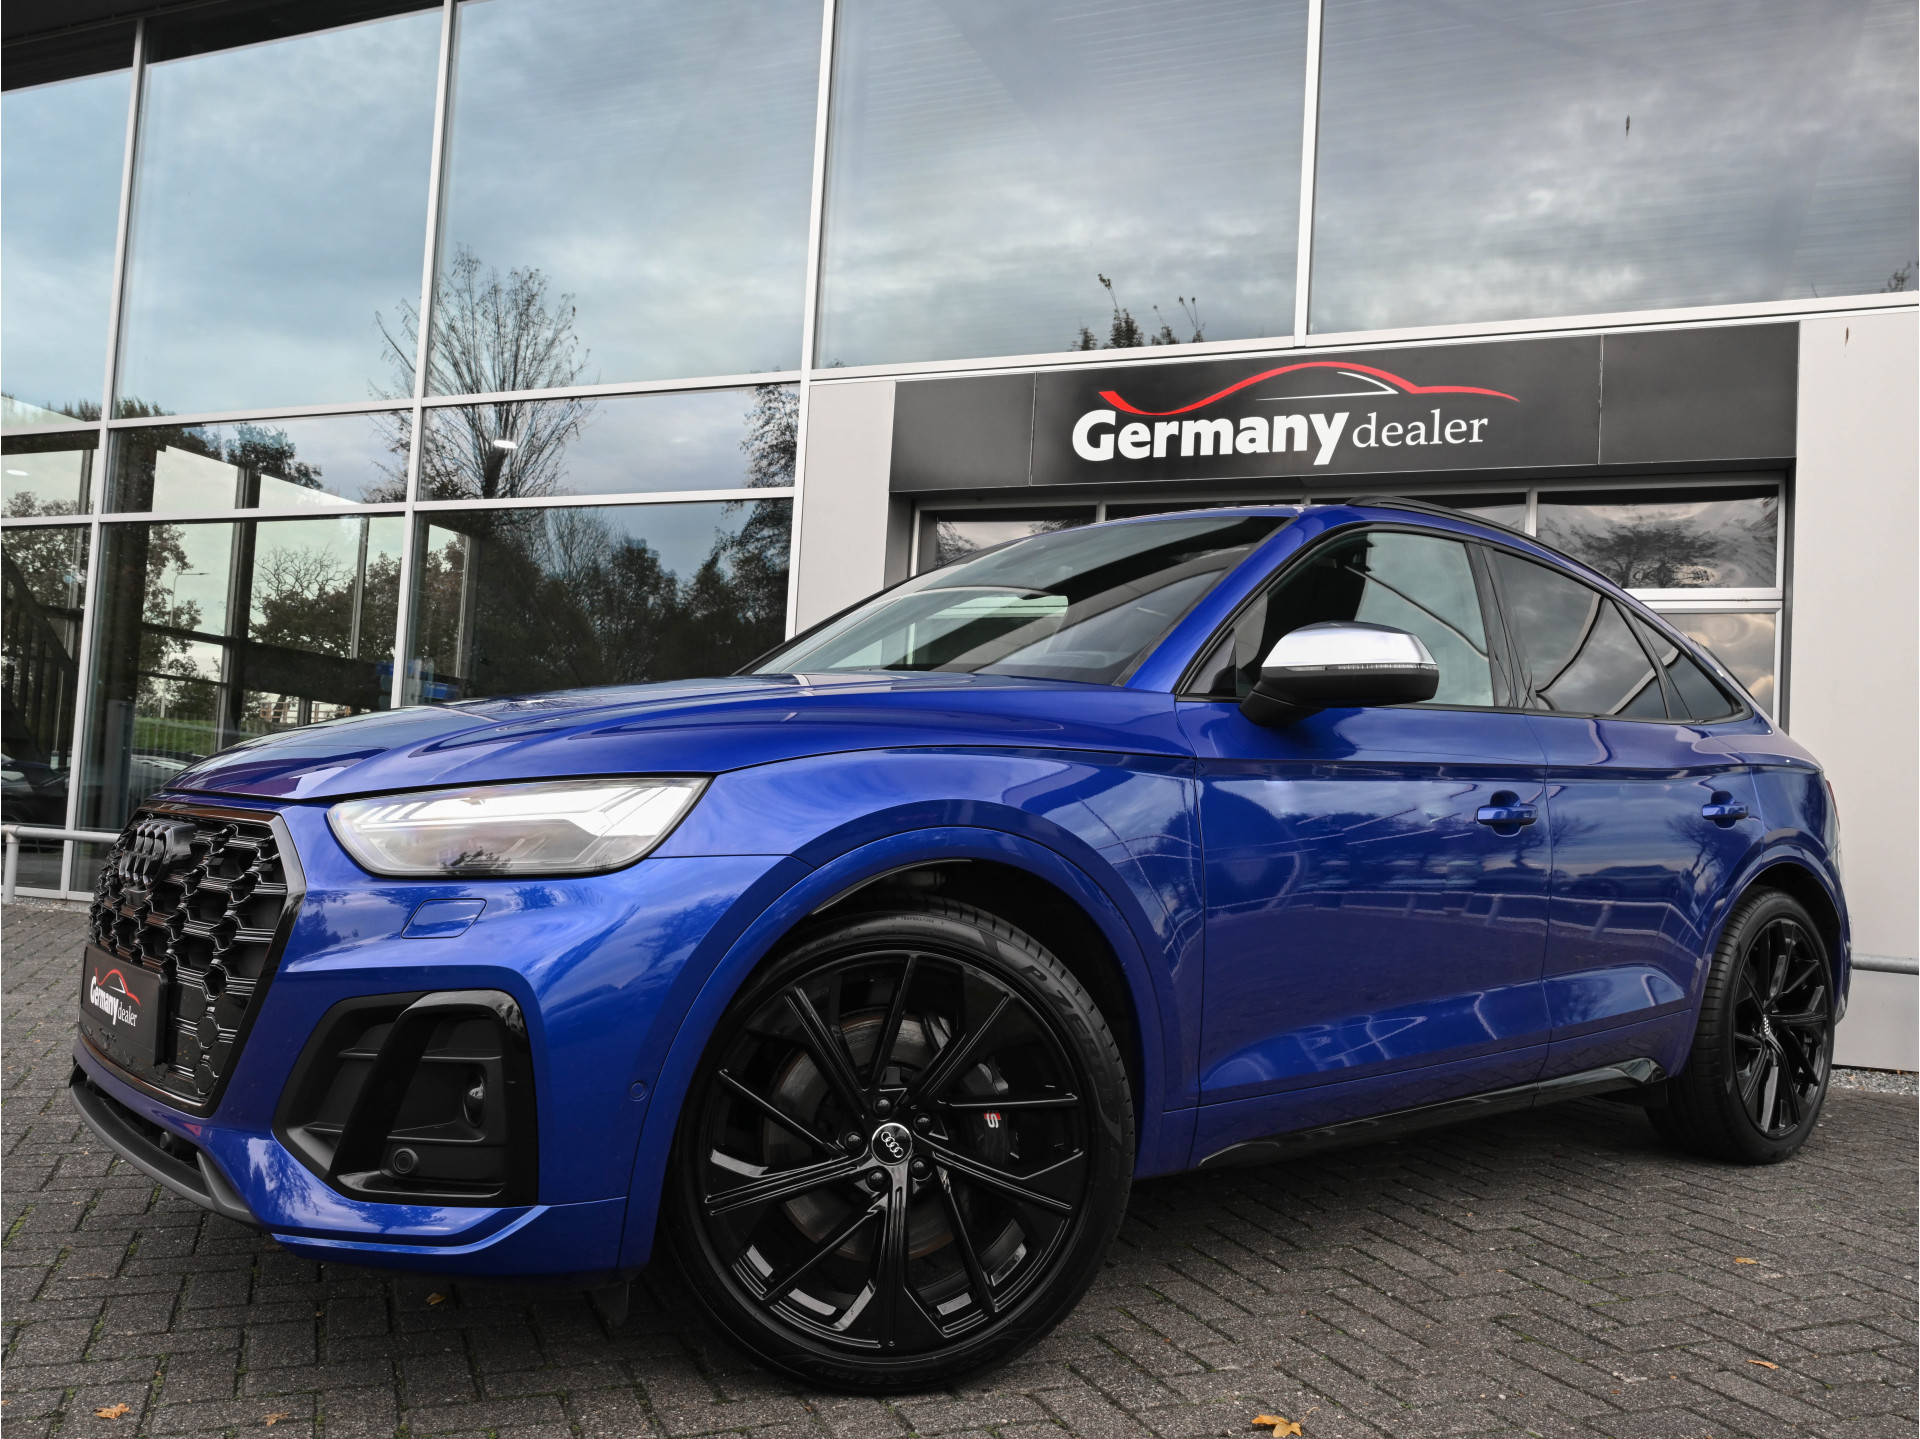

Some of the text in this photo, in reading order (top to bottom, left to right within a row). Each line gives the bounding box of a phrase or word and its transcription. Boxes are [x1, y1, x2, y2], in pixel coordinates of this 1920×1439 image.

[1072, 408, 1489, 466] Germany dealer
[1018, 965, 1048, 982] P
[90, 975, 138, 1027] Germany dealer
